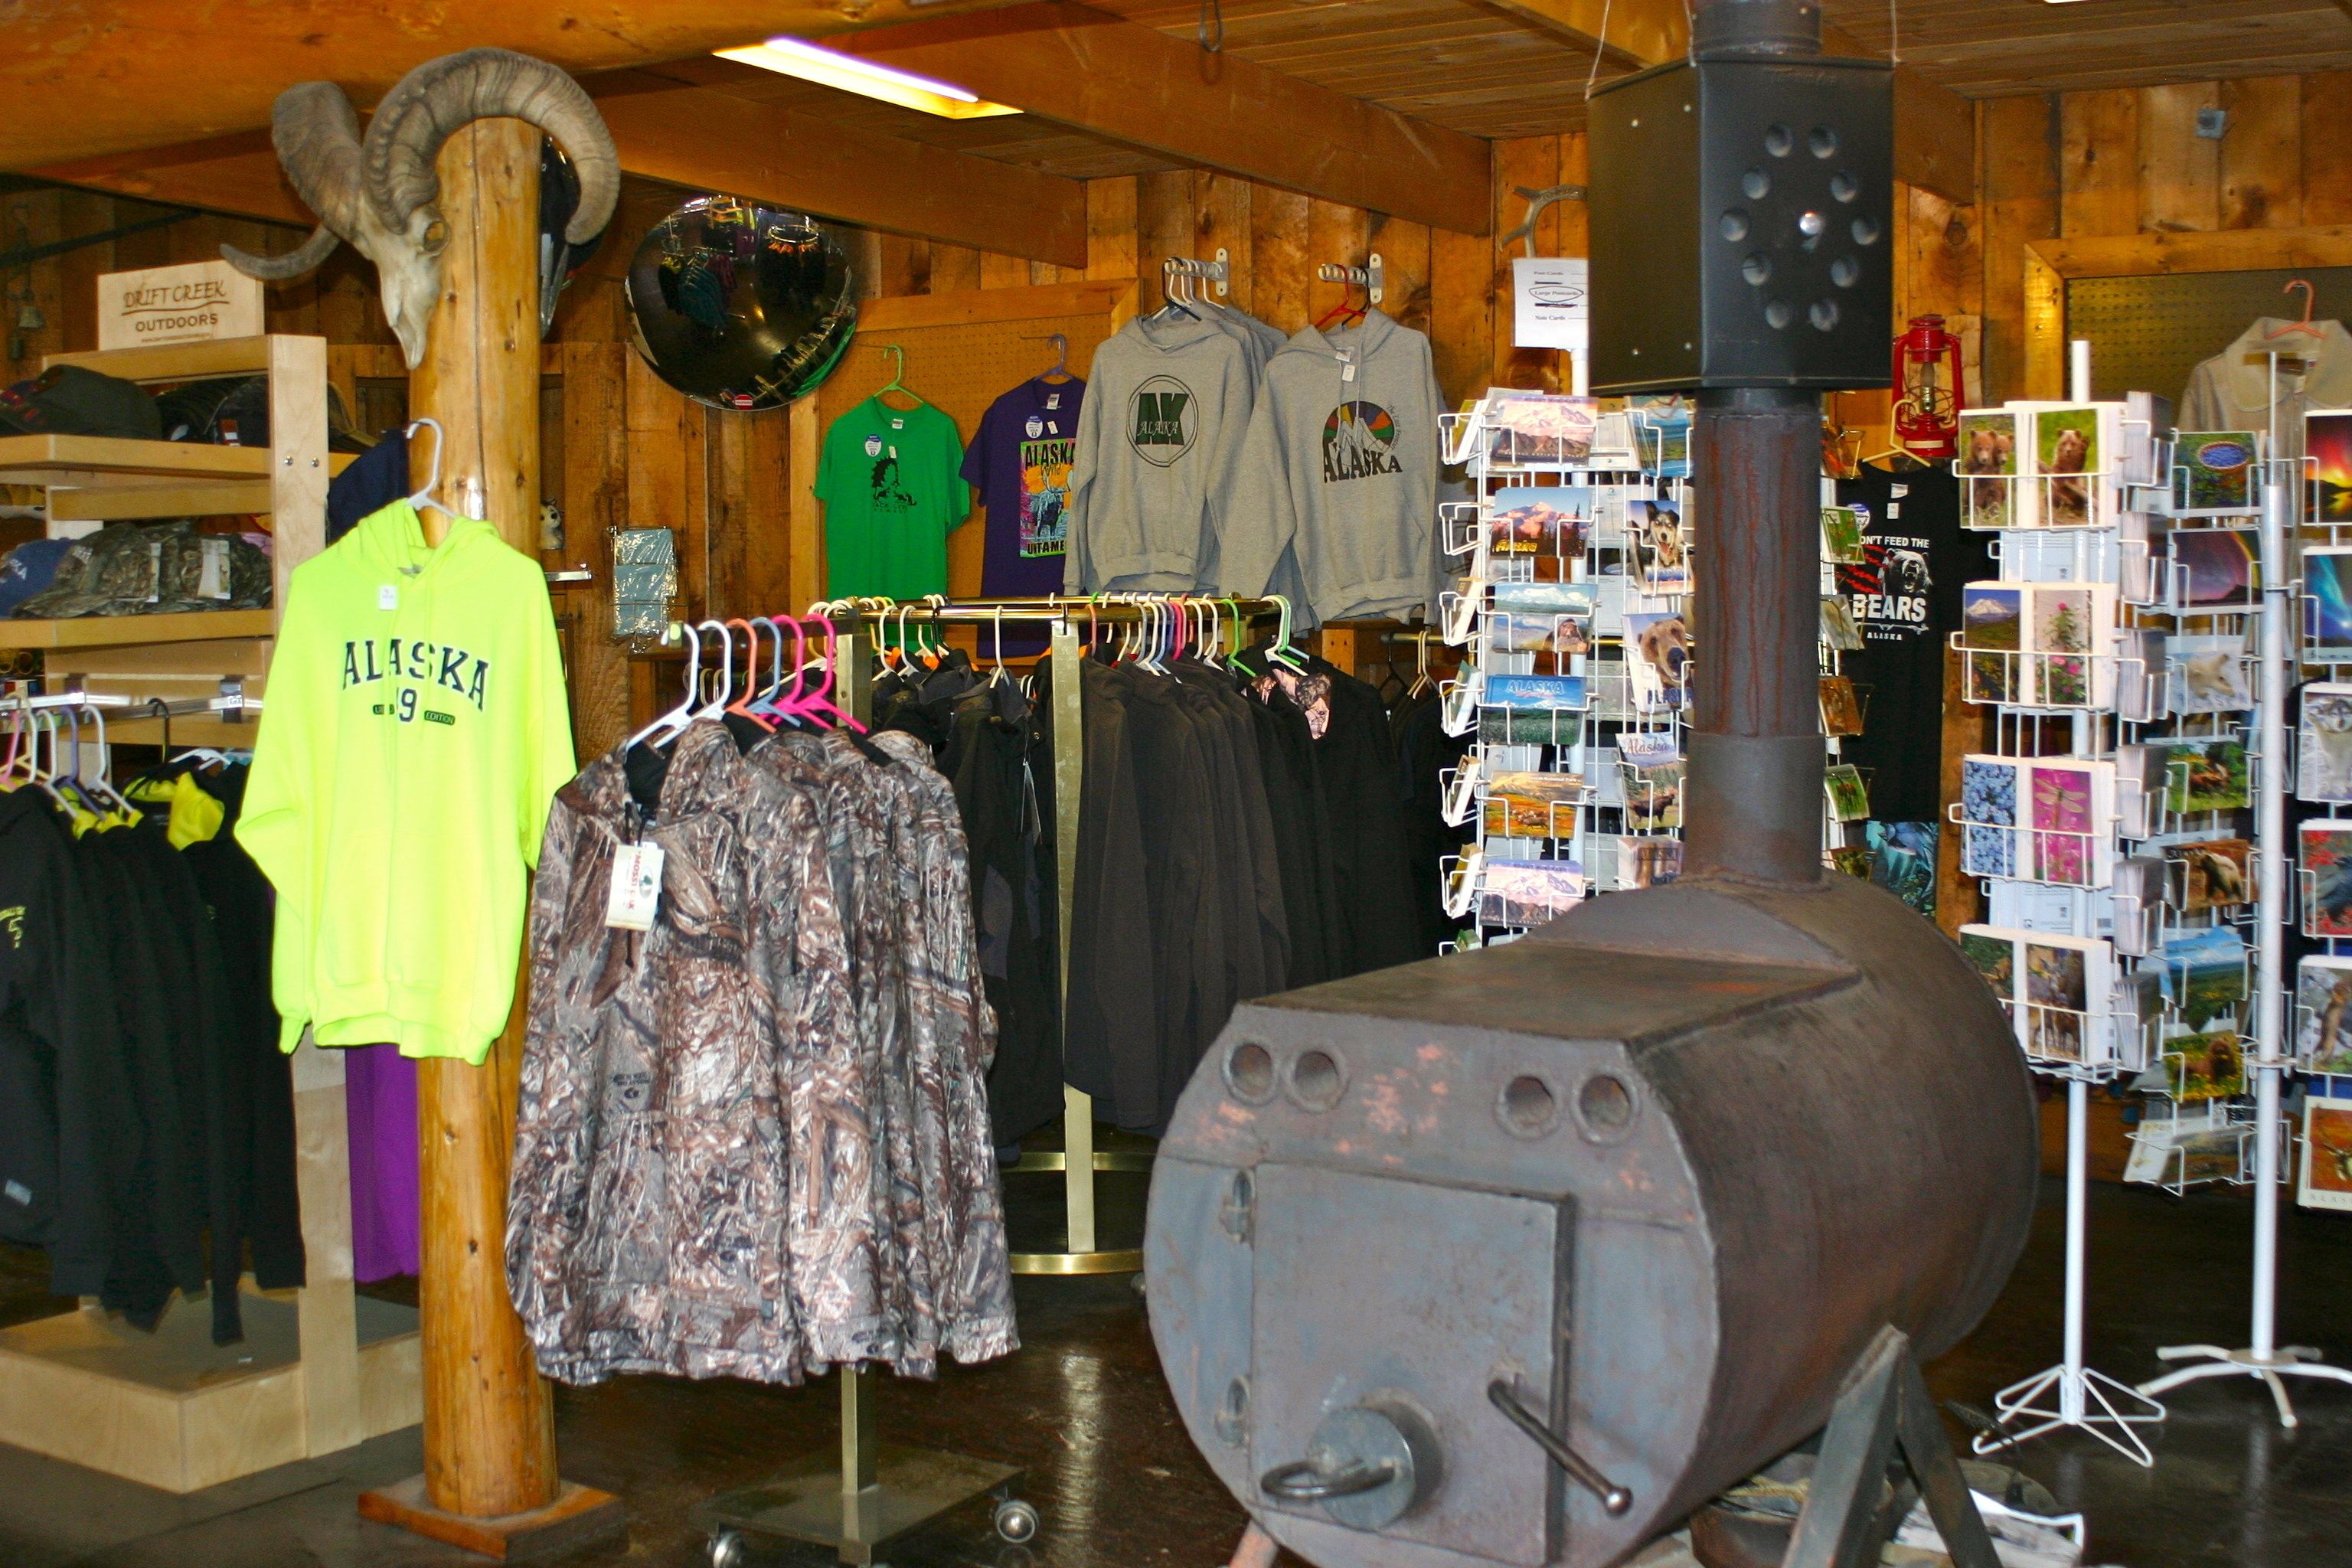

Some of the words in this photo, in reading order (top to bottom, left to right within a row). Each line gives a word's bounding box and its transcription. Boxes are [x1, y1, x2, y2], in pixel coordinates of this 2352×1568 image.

[123, 285, 171, 308] DRIFT
[172, 280, 226, 302] CREEK
[135, 313, 219, 332] OUTDOORS
[1135, 392, 1189, 446] AK
[1323, 441, 1403, 483] ALASKA
[1860, 535, 1883, 544] ON'T
[1884, 537, 1909, 547] FEED
[1911, 538, 1929, 548] THE
[1853, 593, 1926, 622] BEARS
[1867, 632, 1903, 641] ALASKA
[342, 639, 489, 712] ALASKA
[1505, 680, 1565, 695] ALASKA
[426, 711, 455, 724] EDITION
[1628, 737, 1668, 756] Alaska
